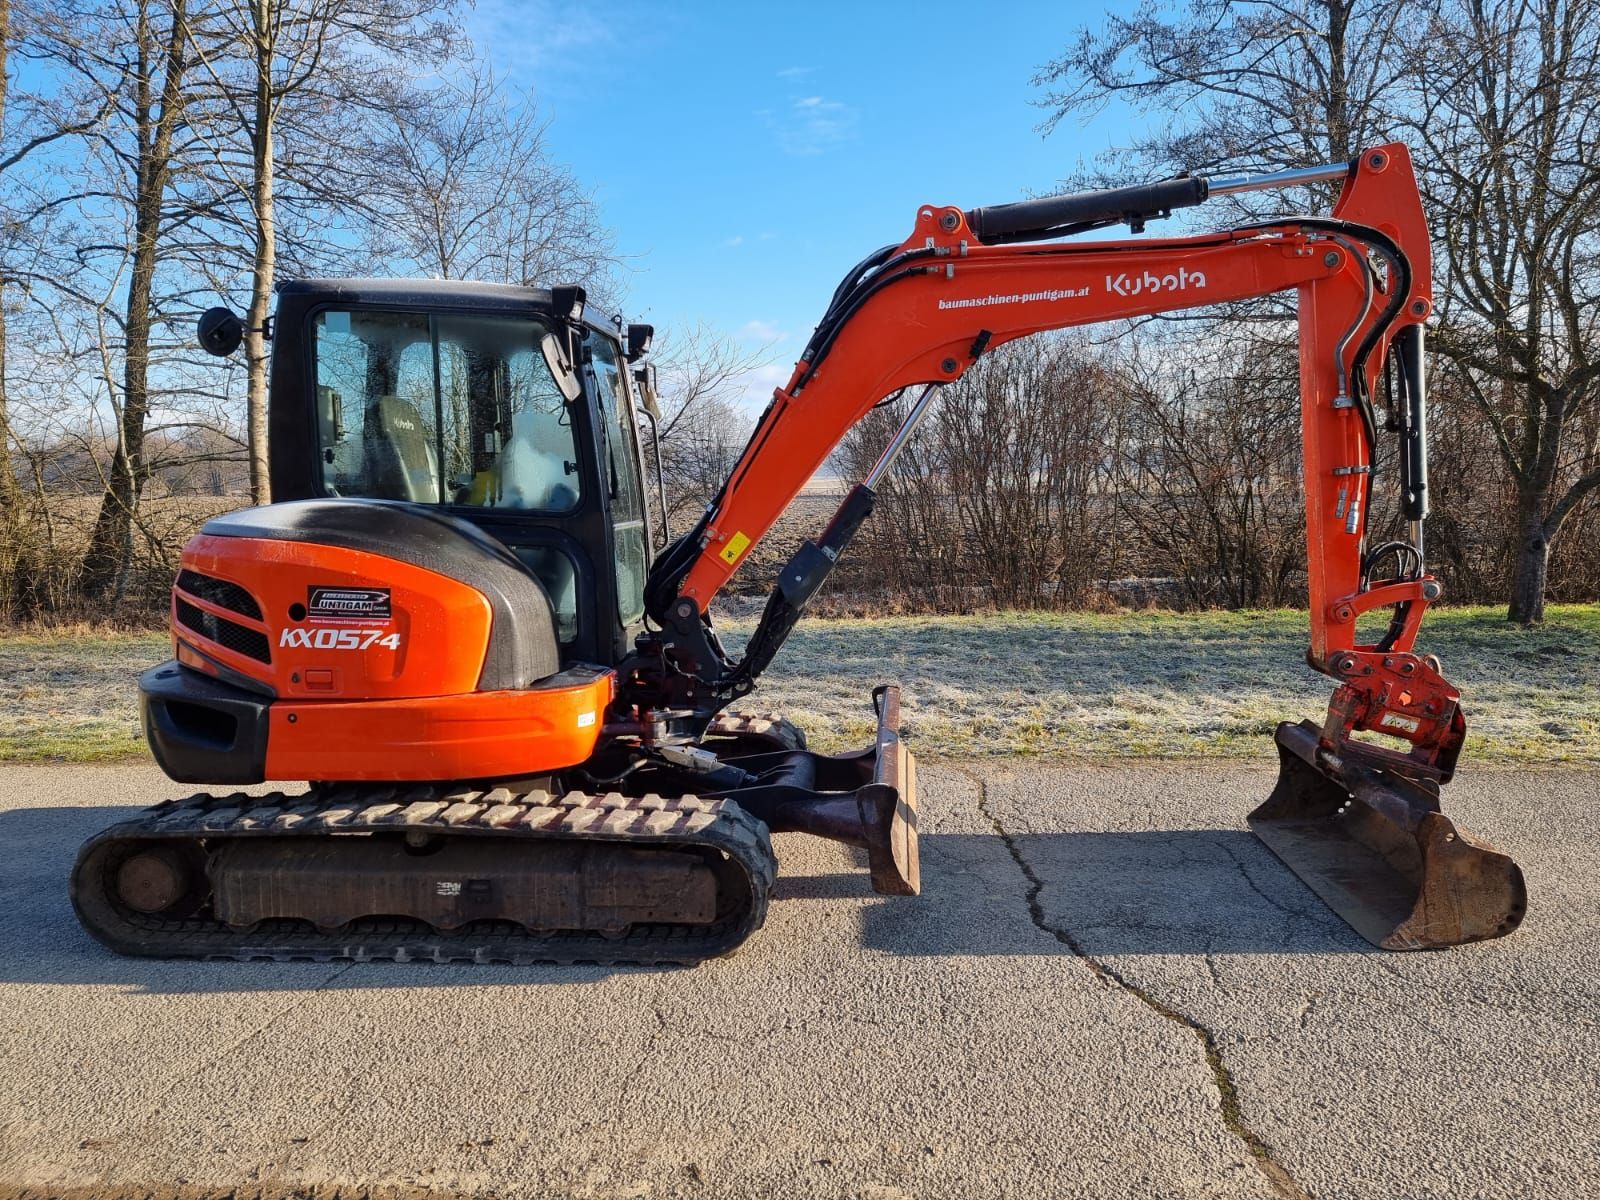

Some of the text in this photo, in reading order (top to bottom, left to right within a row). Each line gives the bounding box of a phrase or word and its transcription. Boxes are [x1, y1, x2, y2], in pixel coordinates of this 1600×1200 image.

[1105, 267, 1206, 296] Kubota
[938, 286, 1090, 310] baumaschinen-puntigam.at
[279, 628, 401, 650] KX057-4
